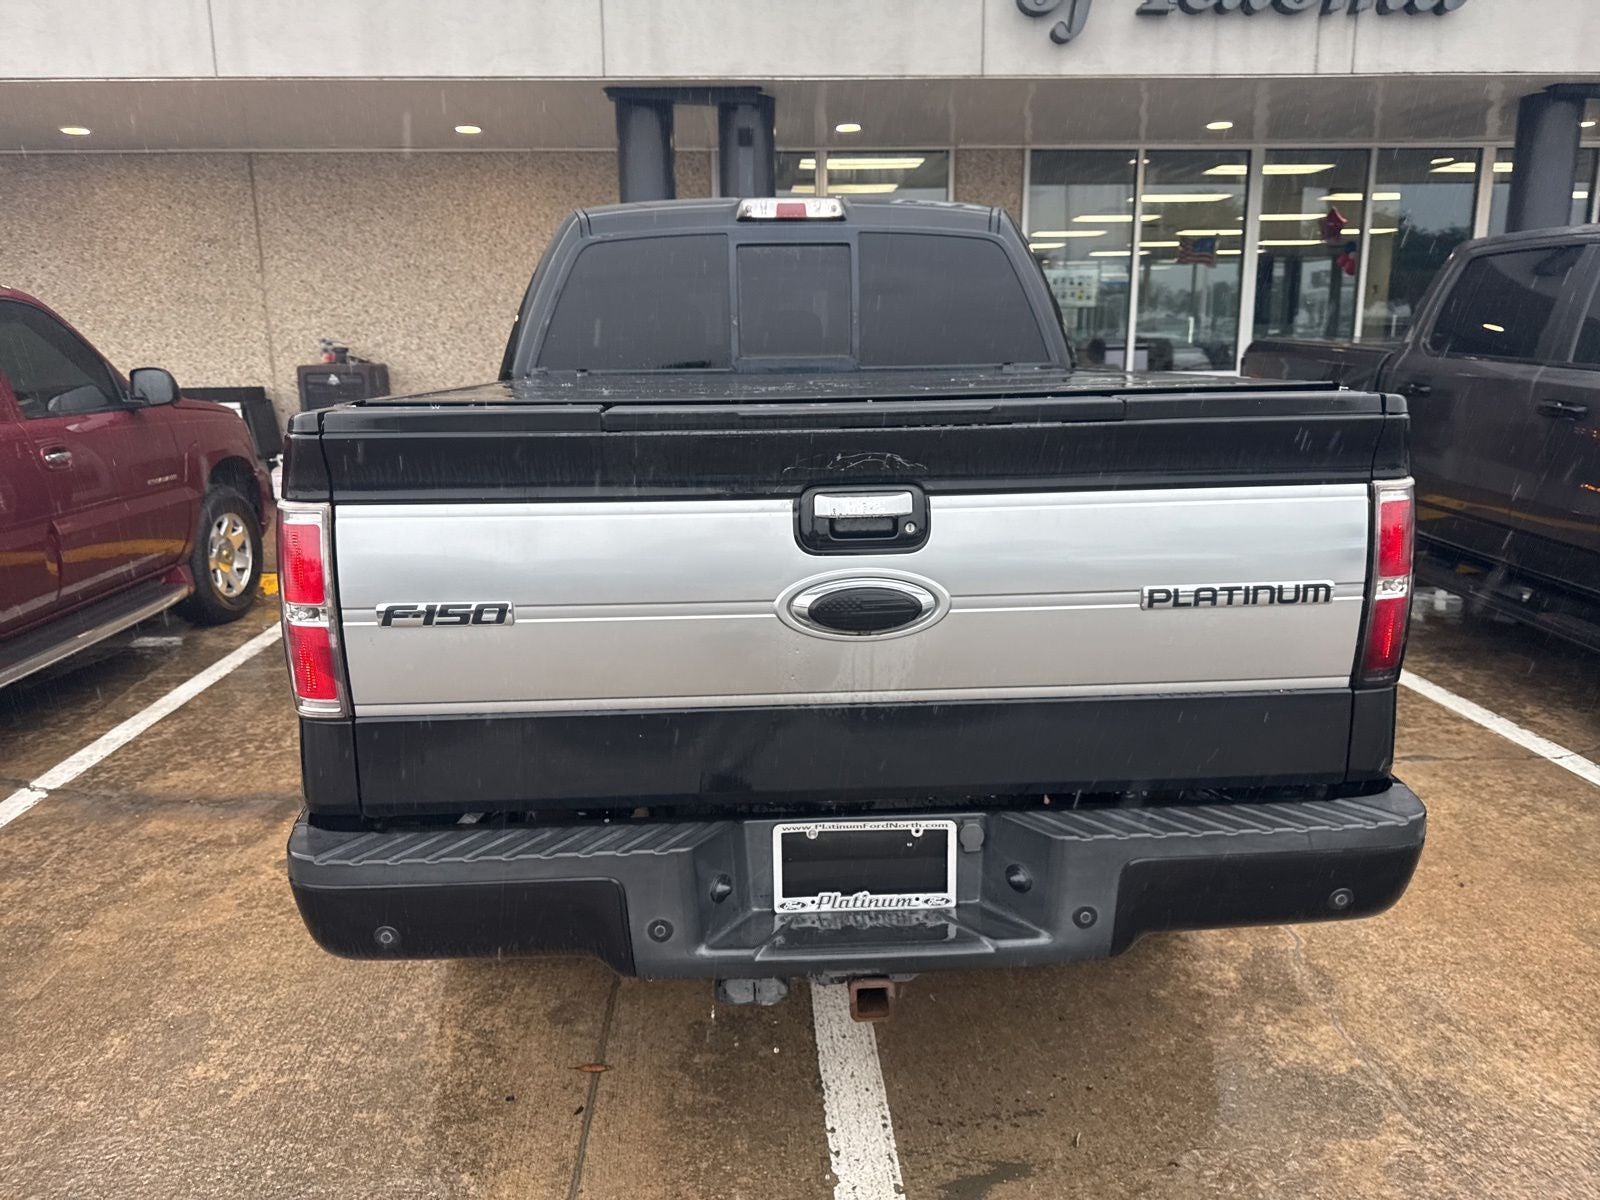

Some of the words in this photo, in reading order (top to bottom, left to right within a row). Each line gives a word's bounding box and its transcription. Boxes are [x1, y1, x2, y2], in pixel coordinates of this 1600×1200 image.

[1147, 583, 1331, 608] PLATINUM
[380, 603, 509, 627] F-150
[782, 822, 949, 831] wwwPlatinumFordNorth.com
[816, 894, 919, 909] Platinum
